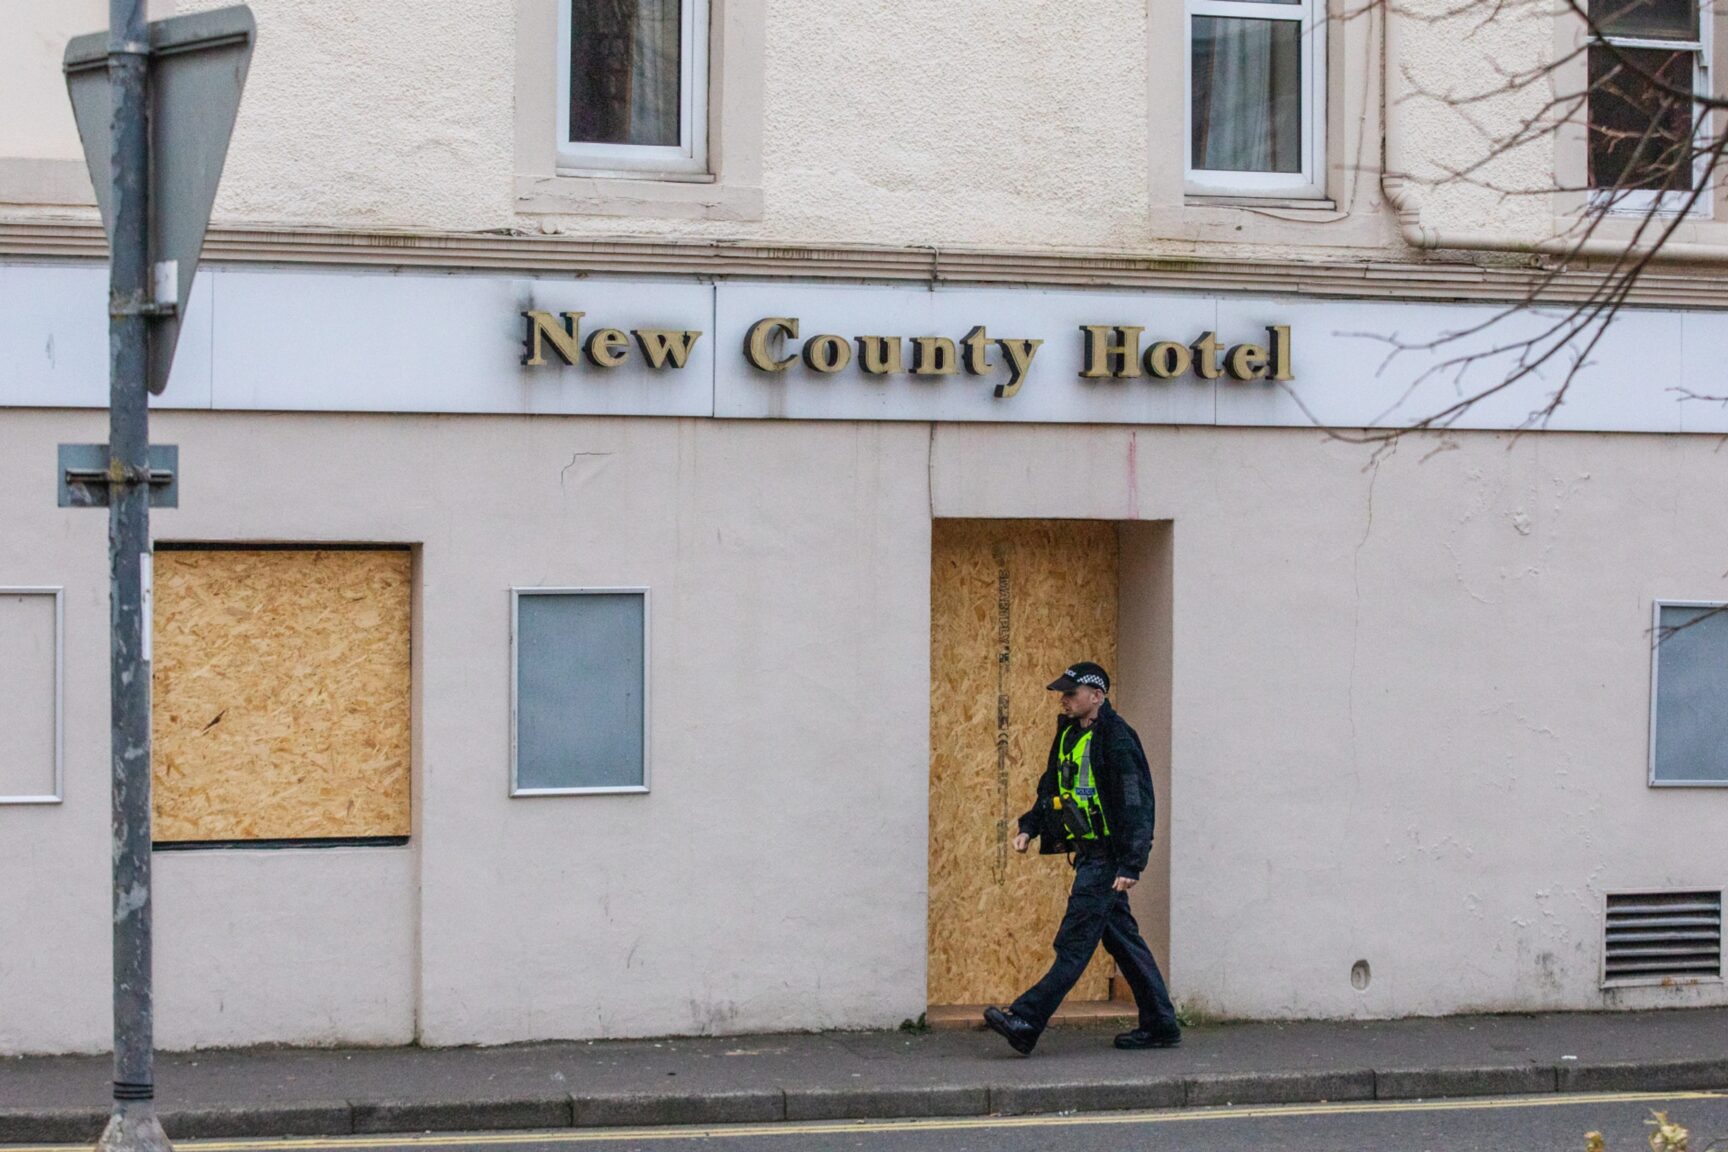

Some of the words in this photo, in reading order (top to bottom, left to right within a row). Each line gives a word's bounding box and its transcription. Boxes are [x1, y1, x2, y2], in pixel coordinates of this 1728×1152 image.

[521, 311, 702, 368] New
[743, 317, 1044, 397] County
[1078, 325, 1294, 380] Hotel
